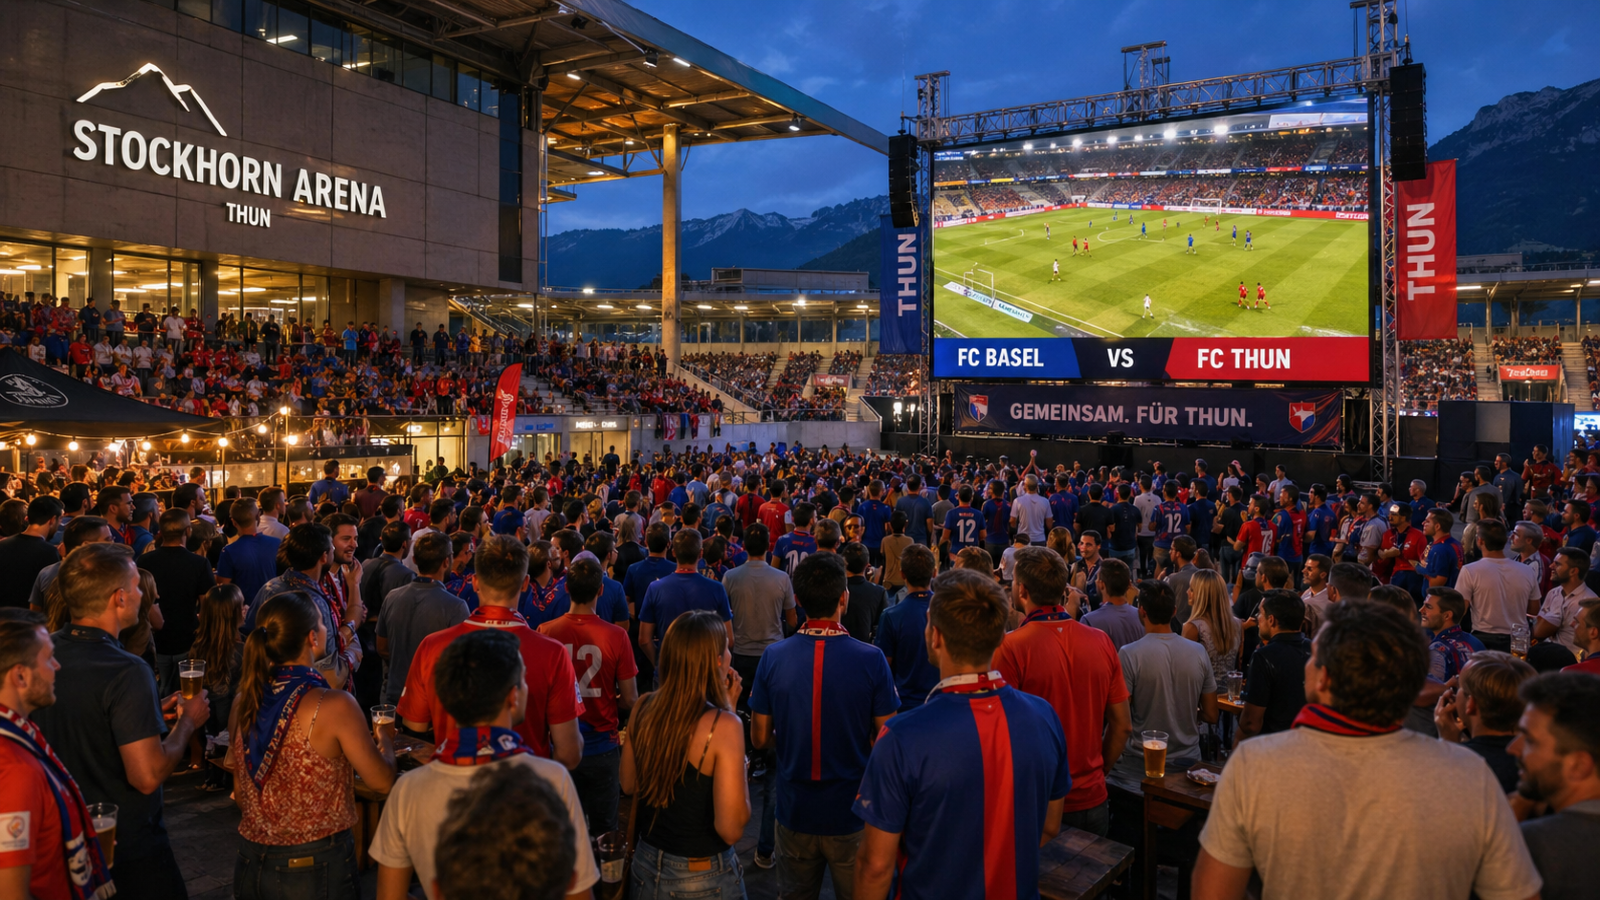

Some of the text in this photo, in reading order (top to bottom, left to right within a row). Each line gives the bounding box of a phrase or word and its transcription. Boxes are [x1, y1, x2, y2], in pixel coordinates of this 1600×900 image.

[73, 118, 387, 219] STOCKHORN ARENA
[226, 201, 271, 228] THUN
[1406, 202, 1437, 301] THUN
[896, 233, 918, 318] THUN
[958, 347, 1045, 369] FC BASEL
[1106, 348, 1135, 368] VS
[1197, 348, 1291, 369] FC THUN
[1009, 402, 1253, 427] GEMEINSAM. FÜR THUN.
[956, 519, 977, 543] 12
[1164, 513, 1182, 534] 12
